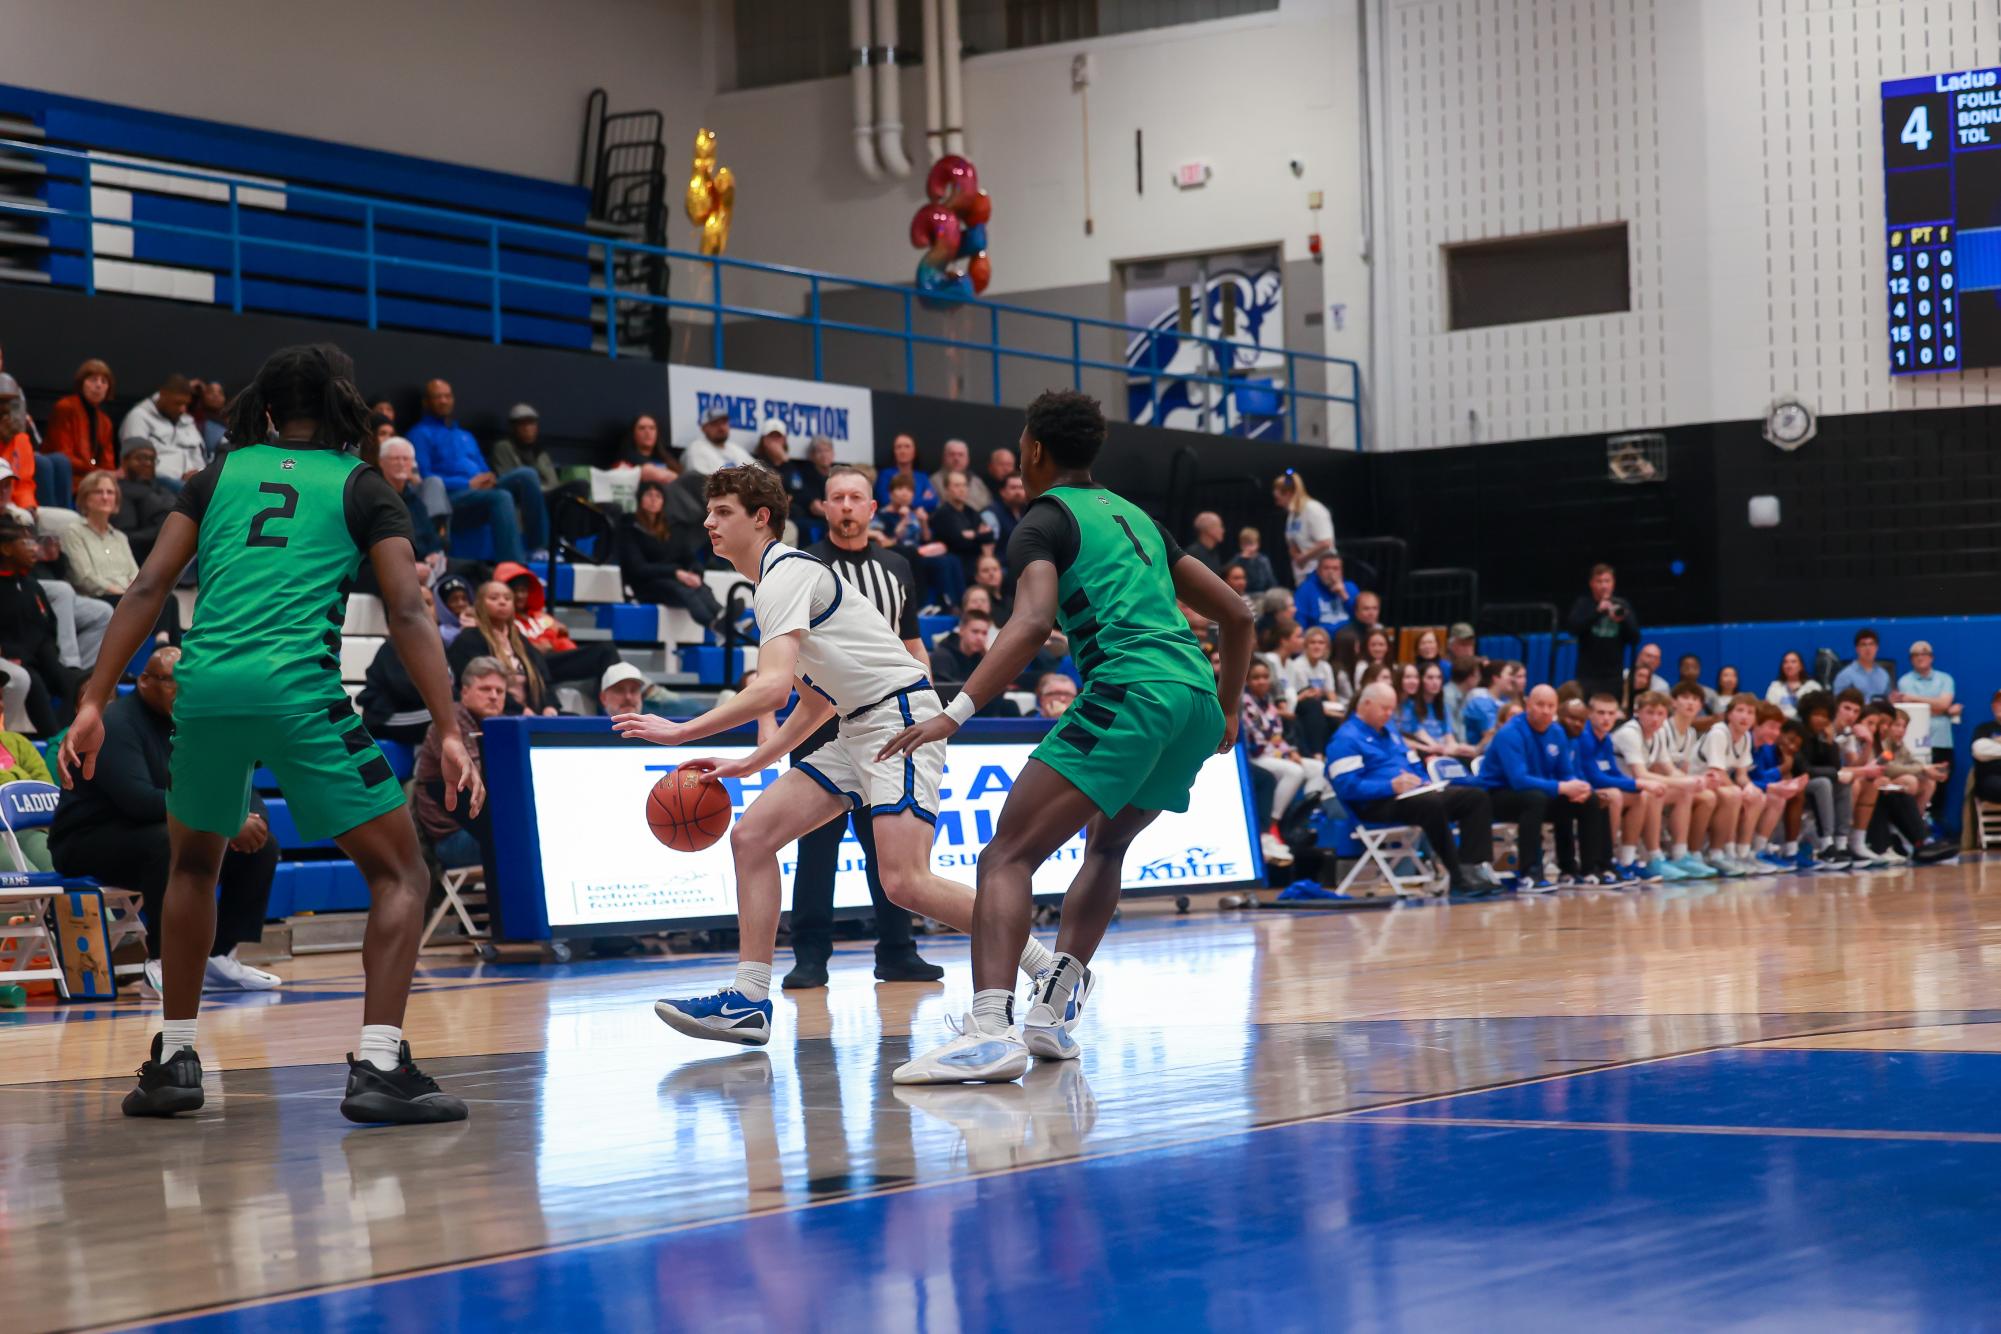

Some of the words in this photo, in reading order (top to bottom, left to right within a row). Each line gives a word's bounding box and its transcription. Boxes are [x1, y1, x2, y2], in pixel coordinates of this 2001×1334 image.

[1936, 71, 1997, 92] Ladue
[1957, 90, 2001, 110] FOUL
[1957, 107, 2001, 127] BONU
[1901, 106, 1932, 150] 4
[1958, 127, 1991, 145] TOL
[1911, 226, 1933, 244] PT
[1892, 254, 1904, 271] 5
[1916, 252, 1929, 269] 0
[1940, 249, 1952, 267] 0
[1889, 277, 1910, 294] 12
[1917, 275, 1930, 292] 0
[1941, 273, 1953, 290] 0
[1893, 301, 1906, 318] 4
[1918, 299, 1931, 316] 0
[1942, 297, 1952, 314] 1
[1890, 325, 1912, 343] 15
[1919, 323, 1932, 340] 0
[1943, 321, 1953, 338] 1
[1896, 349, 1906, 366] 1
[1920, 347, 1933, 364] 0
[1943, 345, 1956, 362] 0
[245, 481, 300, 548] 2
[1112, 514, 1153, 567] 1
[1, 876, 30, 887] RAMS
[1121, 862, 1238, 883] ADUE
